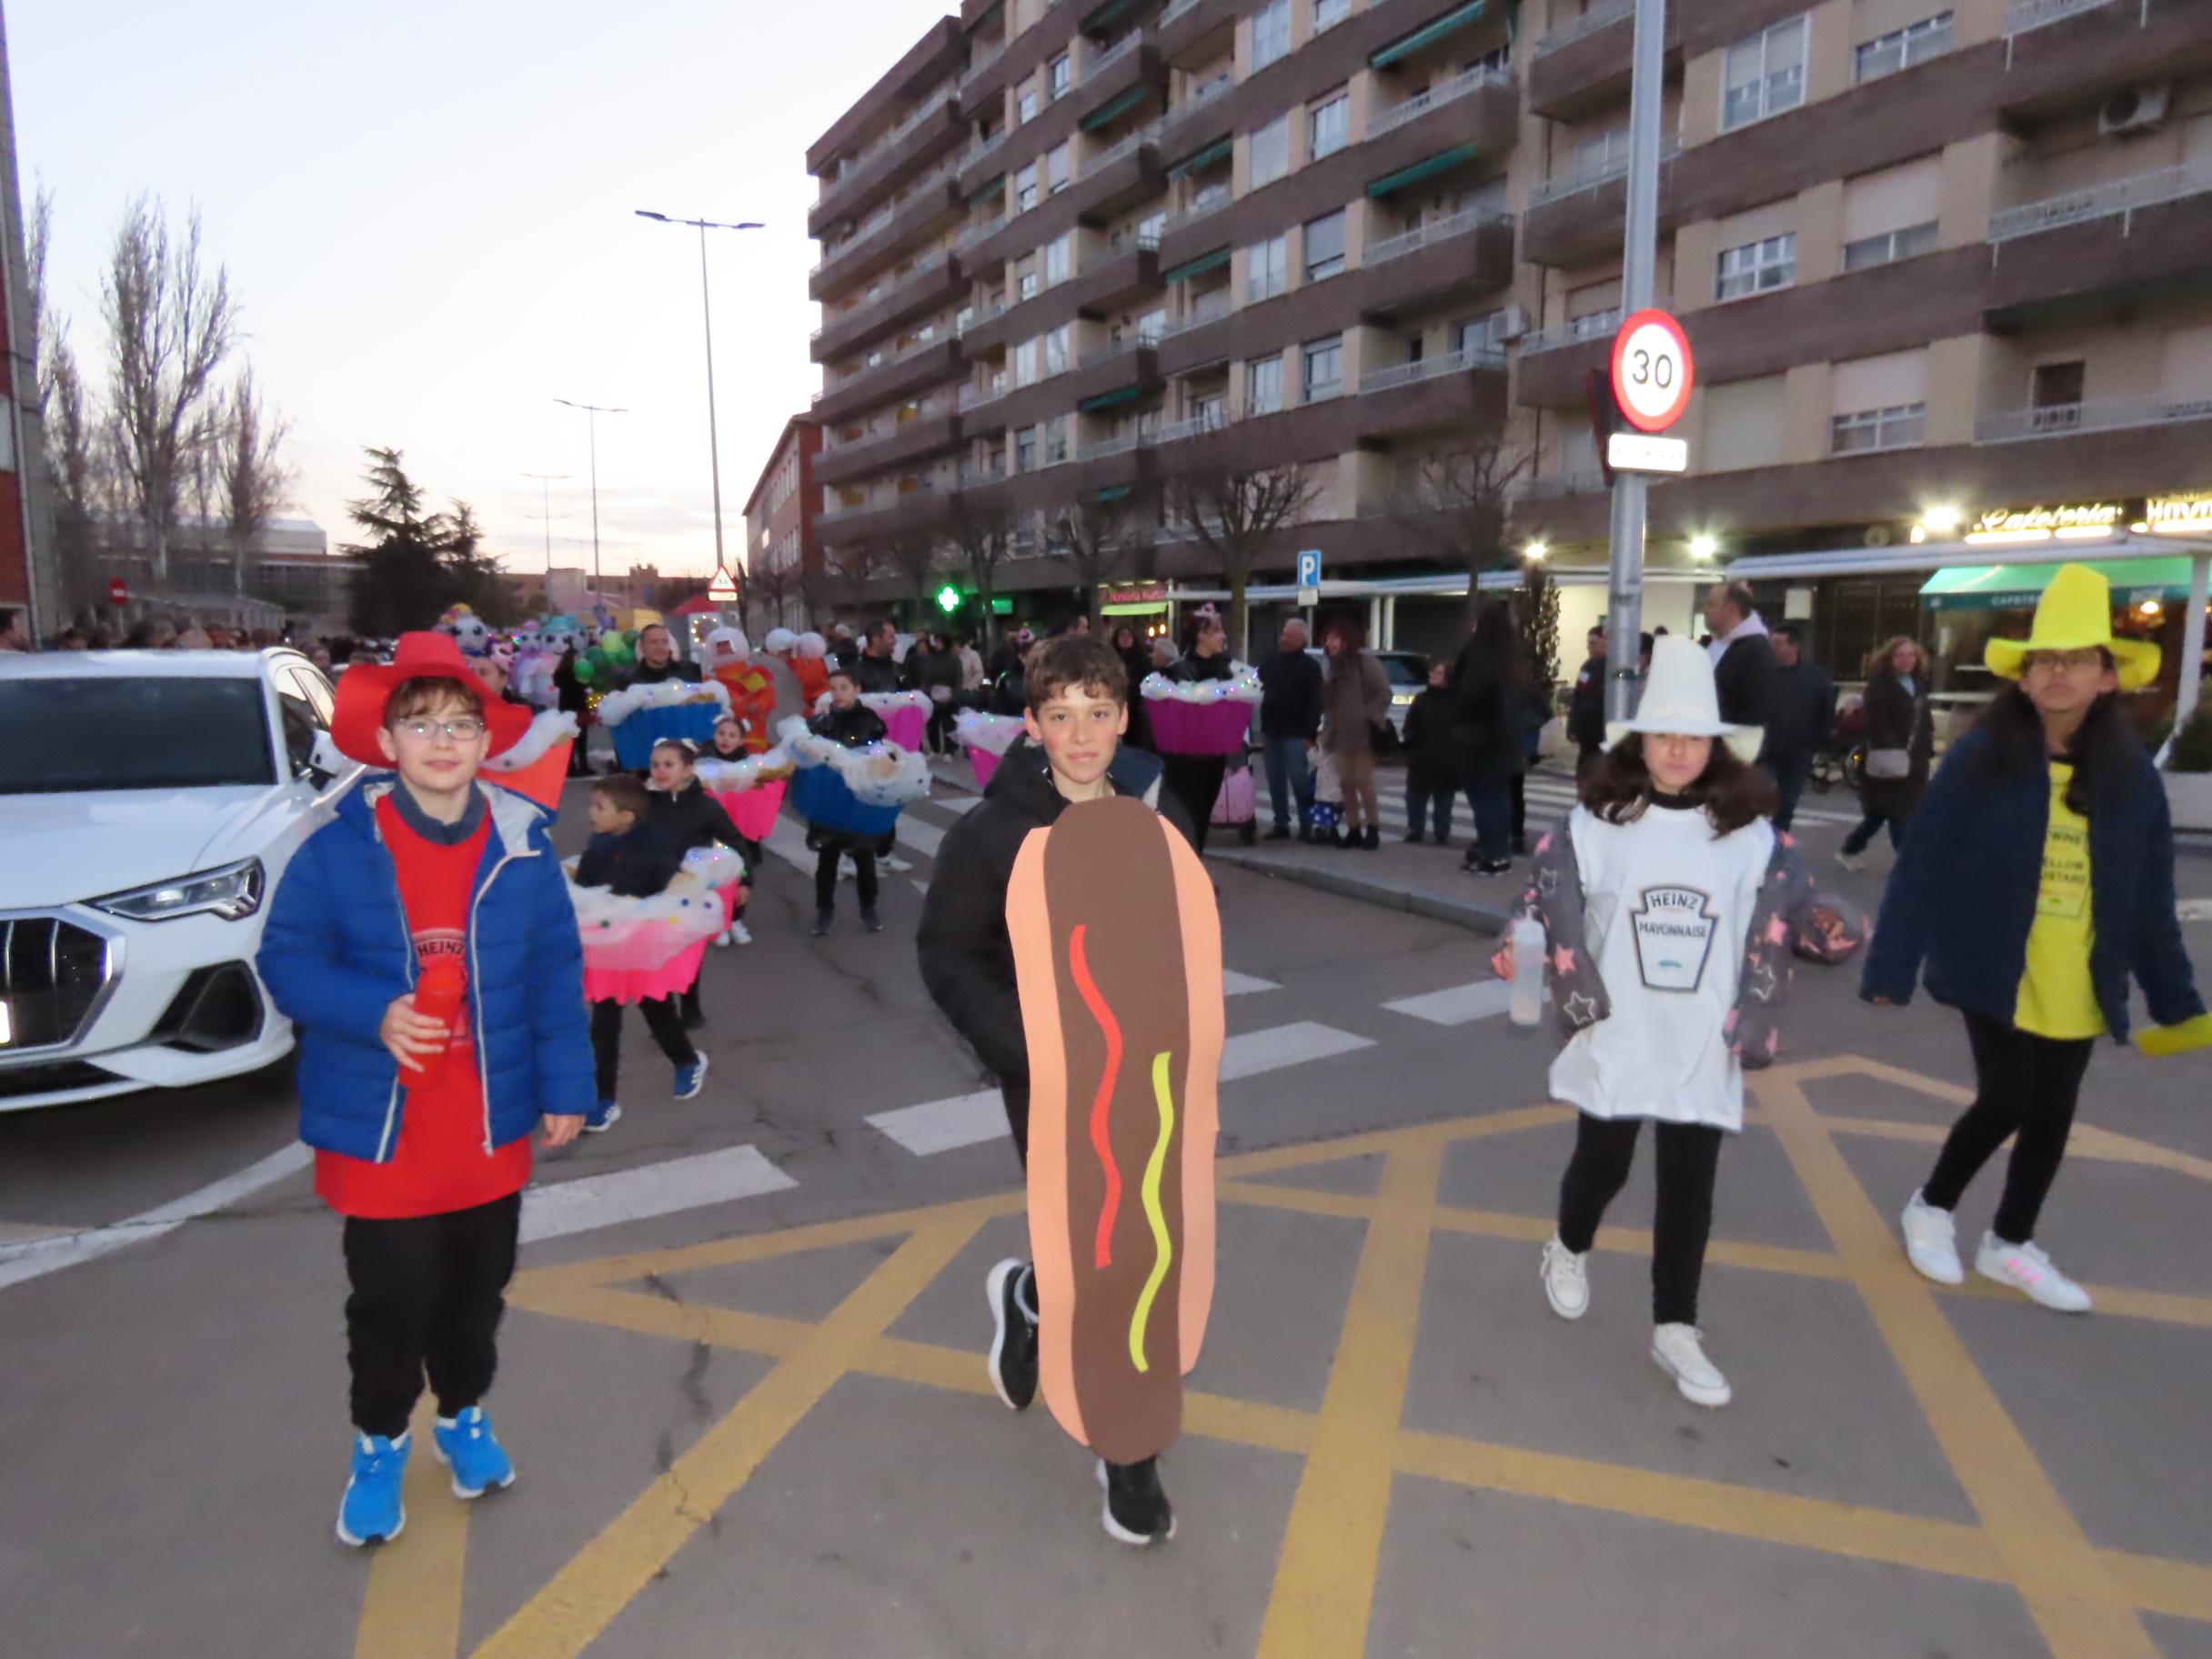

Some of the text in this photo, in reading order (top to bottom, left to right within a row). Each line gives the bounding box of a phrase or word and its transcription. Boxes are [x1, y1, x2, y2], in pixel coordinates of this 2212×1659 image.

[1632, 349, 1673, 389] 30
[1302, 555, 1315, 586] P
[1650, 892, 1698, 910] HEINZ
[1639, 920, 1705, 938] MAYONNAISE
[417, 940, 465, 958] HEINZ
